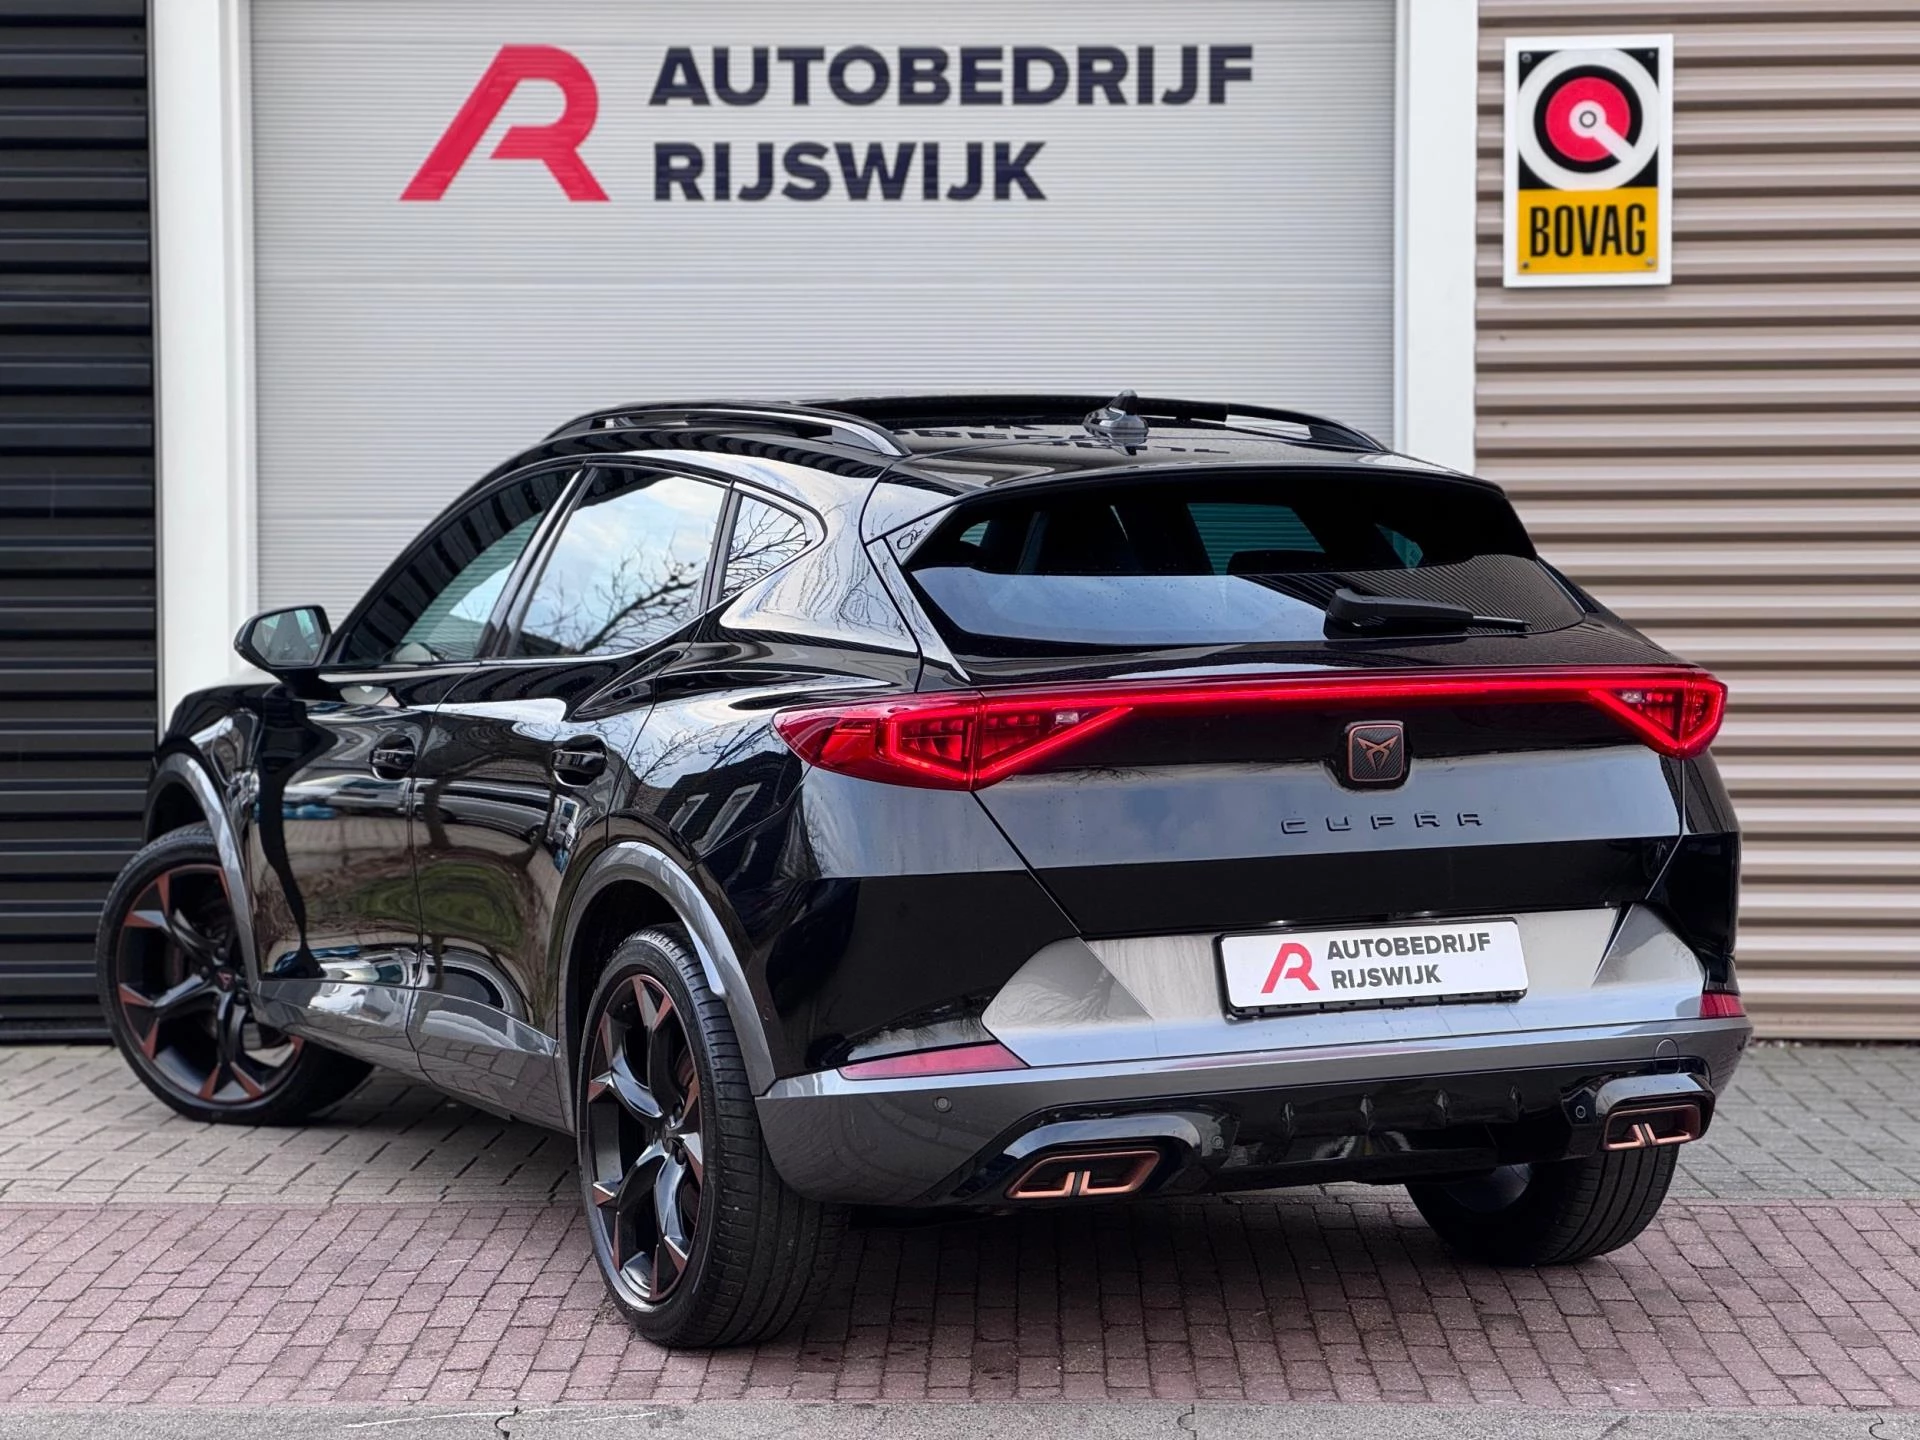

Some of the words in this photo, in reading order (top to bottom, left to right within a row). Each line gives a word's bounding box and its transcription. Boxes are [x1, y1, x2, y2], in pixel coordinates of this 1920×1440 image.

[649, 45, 1253, 106] AUTOBEDRIJF
[653, 142, 1047, 201] RIJSWIJK
[1529, 203, 1646, 257] BOVAG
[1281, 811, 1483, 834] CUPRA
[1327, 932, 1491, 960] AUTOBEDRIJF
[1331, 964, 1442, 989] RIJSWIJK
